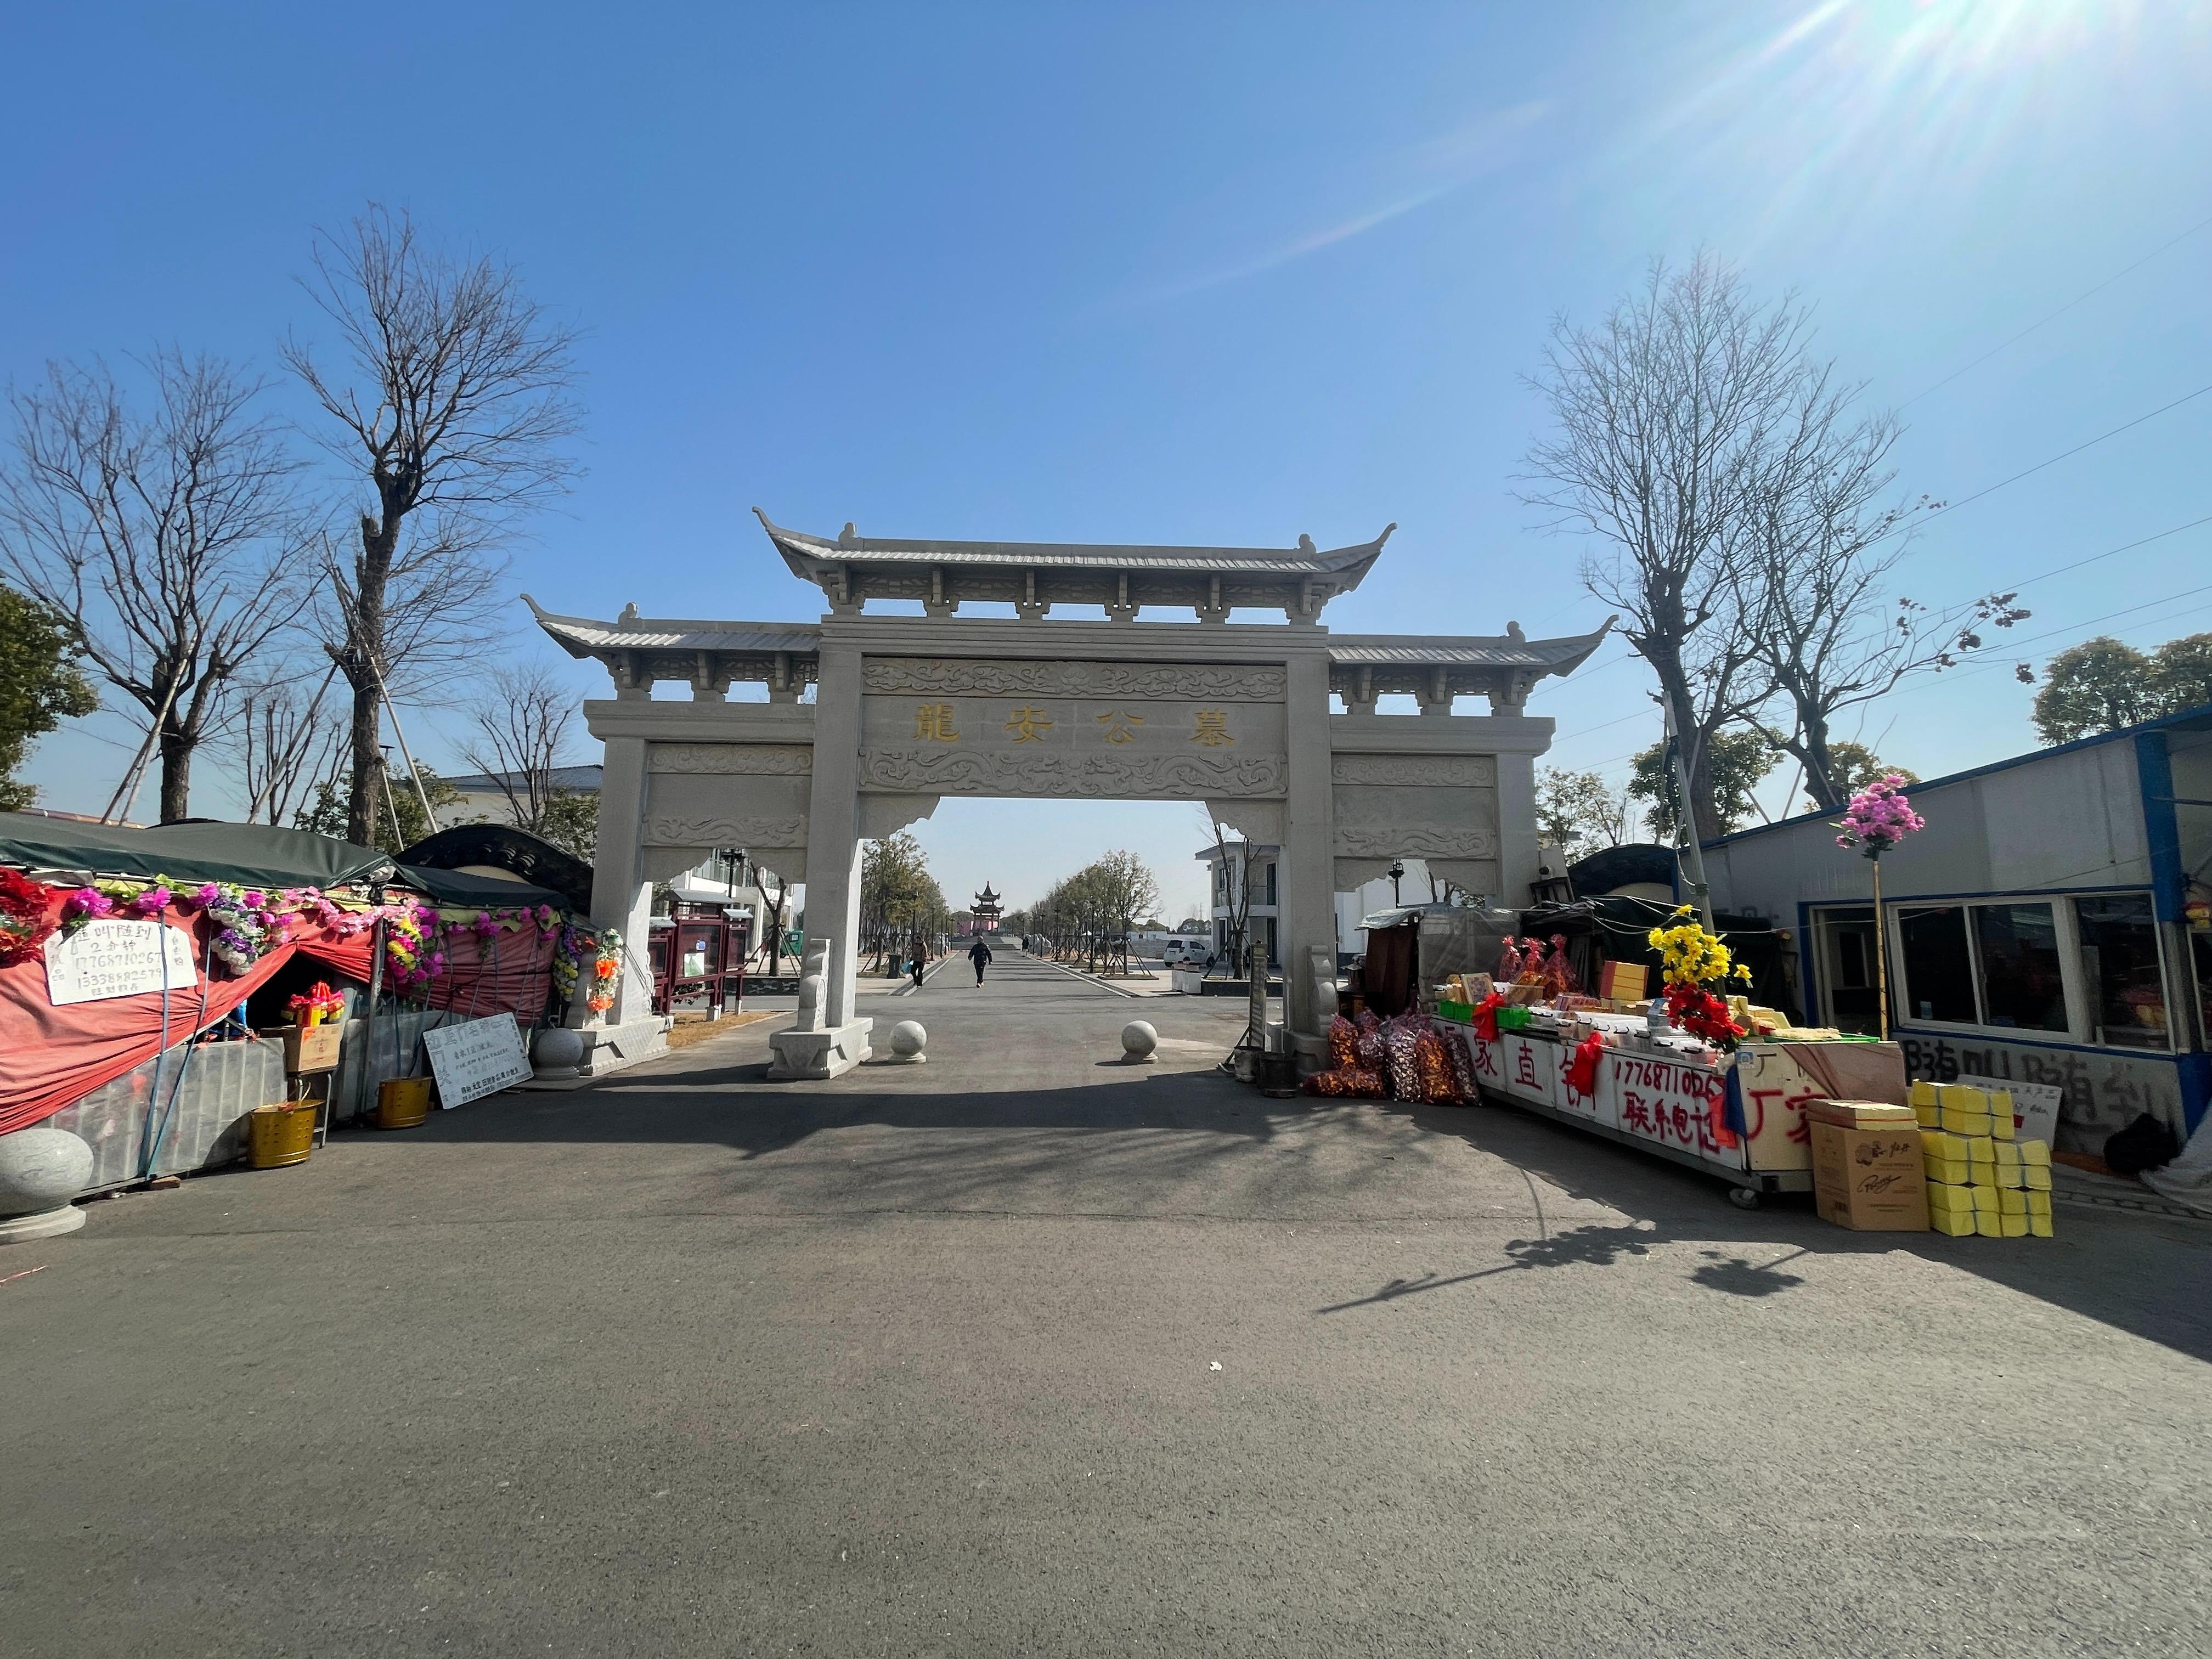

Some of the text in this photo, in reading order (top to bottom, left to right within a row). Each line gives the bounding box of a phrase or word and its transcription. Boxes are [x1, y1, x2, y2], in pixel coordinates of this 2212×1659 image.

[913, 702, 1235, 747] 龍安公墓
[75, 952, 162, 969] 17768710267
[1615, 1061, 1717, 1098] 1776871026
